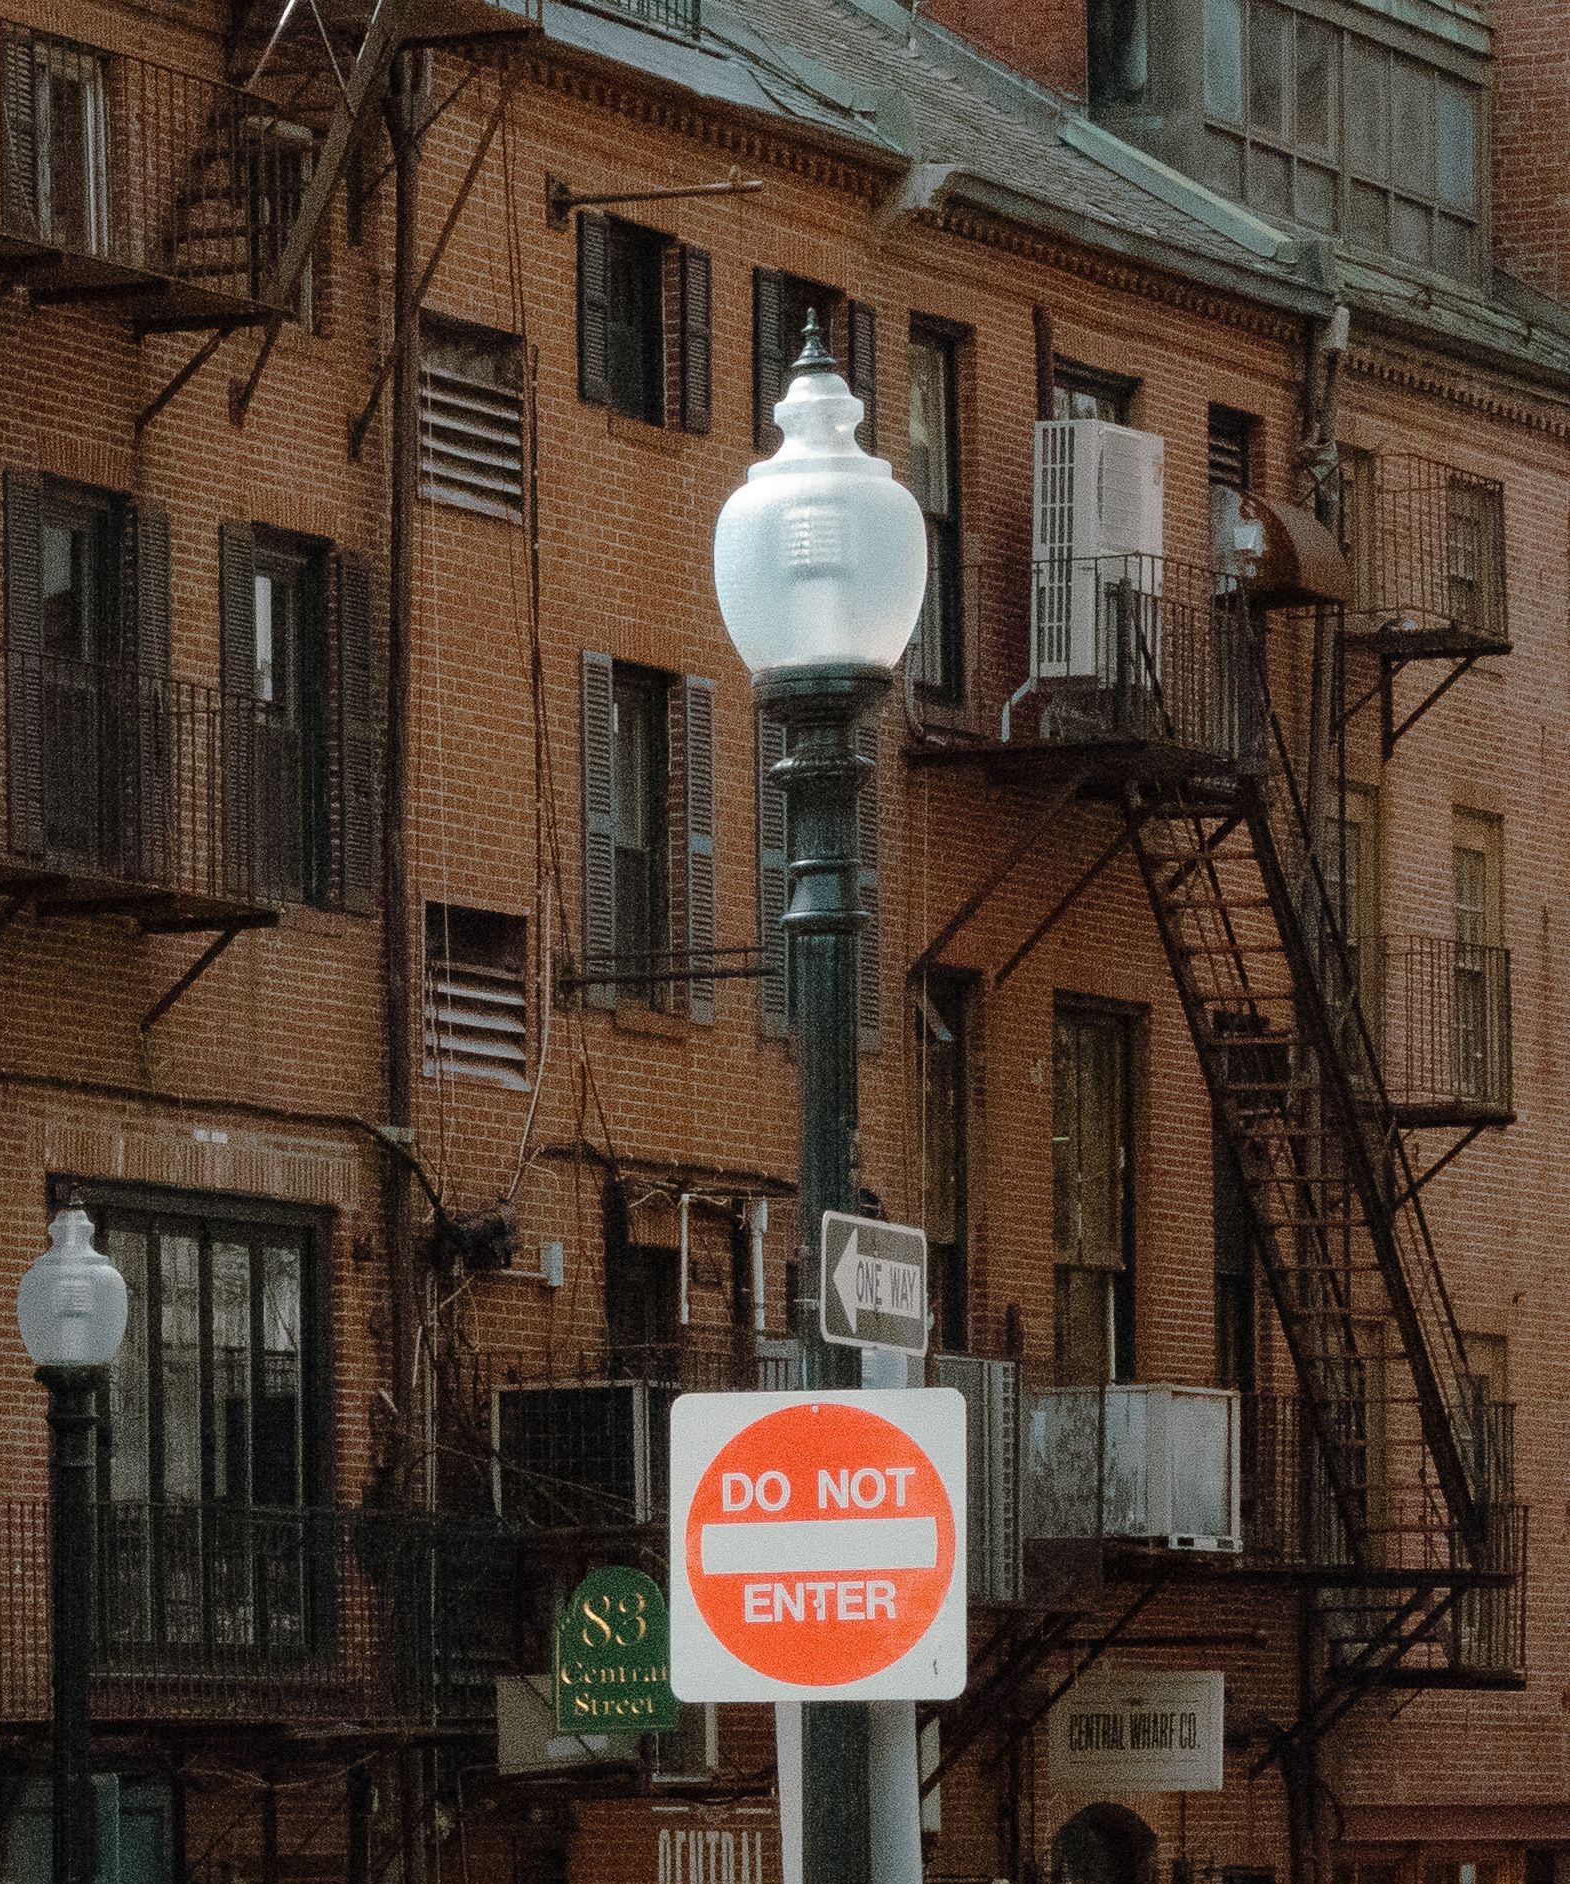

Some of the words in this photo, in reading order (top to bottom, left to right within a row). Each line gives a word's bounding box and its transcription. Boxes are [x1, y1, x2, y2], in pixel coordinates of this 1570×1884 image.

[856, 1260, 882, 1305] ONE
[890, 1265, 917, 1311] WAY
[721, 1470, 791, 1512] DO
[817, 1467, 916, 1510] NOT
[581, 1592, 647, 1647] 83
[743, 1580, 896, 1624] ENTER
[561, 1661, 668, 1685] Central
[574, 1692, 654, 1717] Street
[1069, 1712, 1125, 1750] CENTRAL
[1129, 1712, 1177, 1750] WHARF
[1179, 1711, 1202, 1750] CO.
